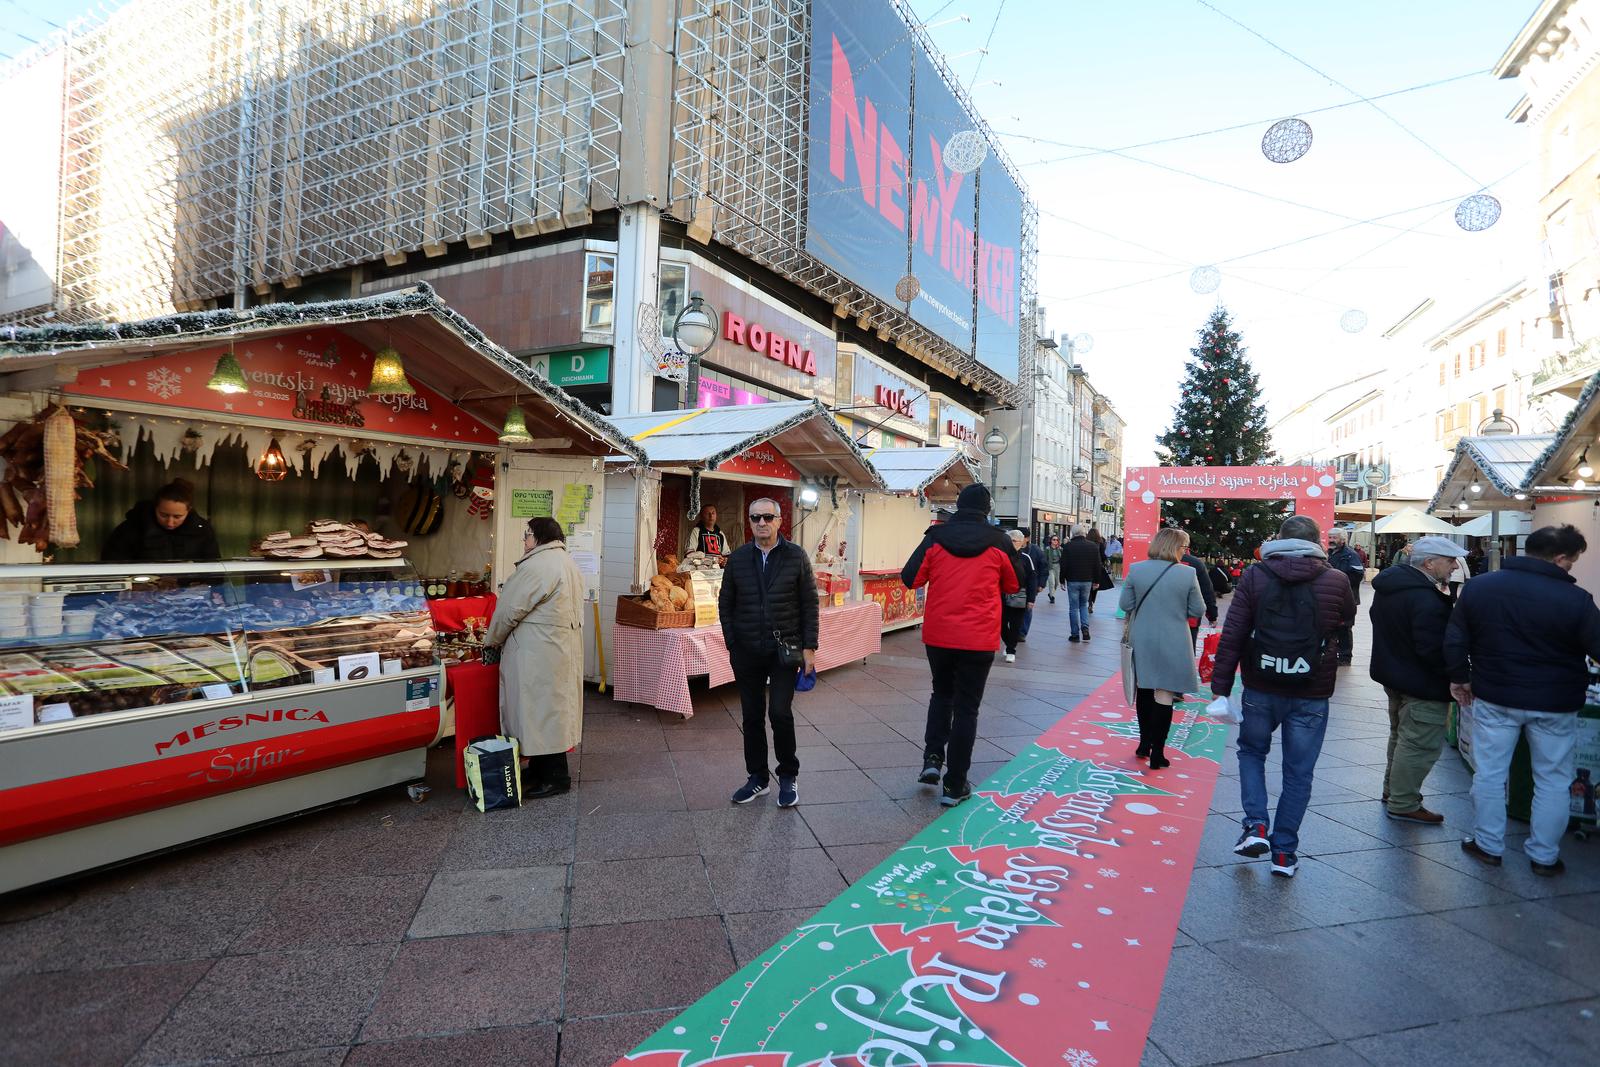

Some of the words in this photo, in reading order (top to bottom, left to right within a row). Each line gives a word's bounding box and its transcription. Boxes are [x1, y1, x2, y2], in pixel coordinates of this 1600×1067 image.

[829, 31, 939, 257] NEW
[930, 133, 1015, 328] YORKER
[723, 311, 817, 376] ROBNA
[561, 374, 595, 382] DEICHMANN
[571, 355, 585, 372] D
[240, 371, 315, 393] ventski
[874, 384, 915, 419] KUĆA
[947, 419, 981, 447] RIJEKA
[1158, 472, 1217, 488] Adventski
[1219, 473, 1254, 490] sajam
[1257, 472, 1300, 491] Rijeka
[1260, 654, 1311, 674] FILA
[154, 708, 331, 756] MESNICA
[1029, 761, 1149, 859] Adventski
[866, 863, 910, 898] Advent
[904, 860, 938, 885] Rijeka
[954, 853, 1069, 951] sajam
